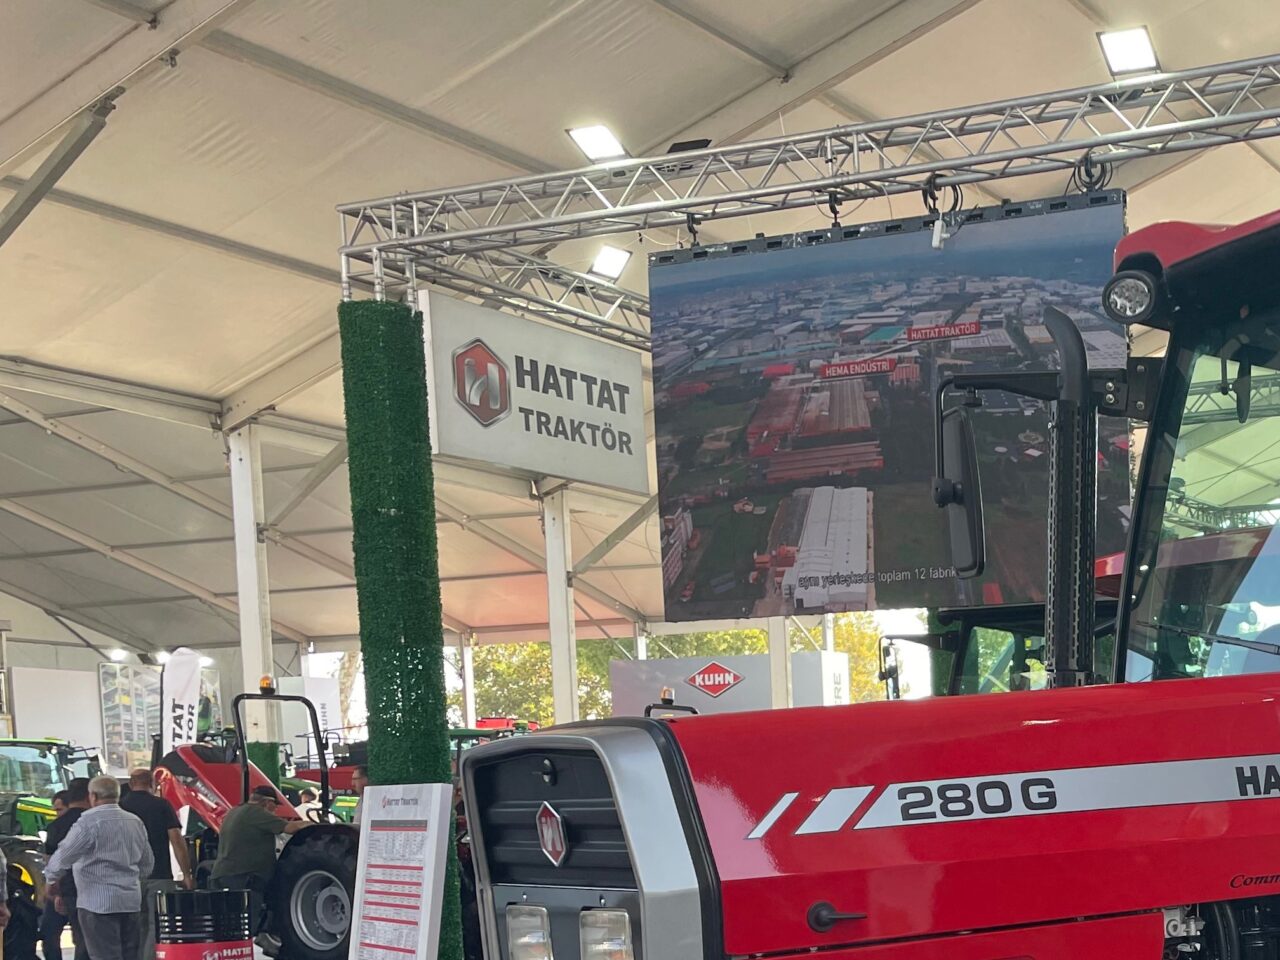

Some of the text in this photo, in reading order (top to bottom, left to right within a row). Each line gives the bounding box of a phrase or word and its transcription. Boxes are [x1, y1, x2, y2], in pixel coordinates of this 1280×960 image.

[911, 323, 976, 340] HATTAT TRAKTÖR
[825, 359, 890, 377] HEMA ENDÜSTRİ
[514, 355, 630, 415] HATTAT
[518, 406, 633, 455] TRAKTÖR
[878, 569, 910, 584] toplam
[915, 567, 926, 580] 12
[695, 673, 734, 687] KUHN
